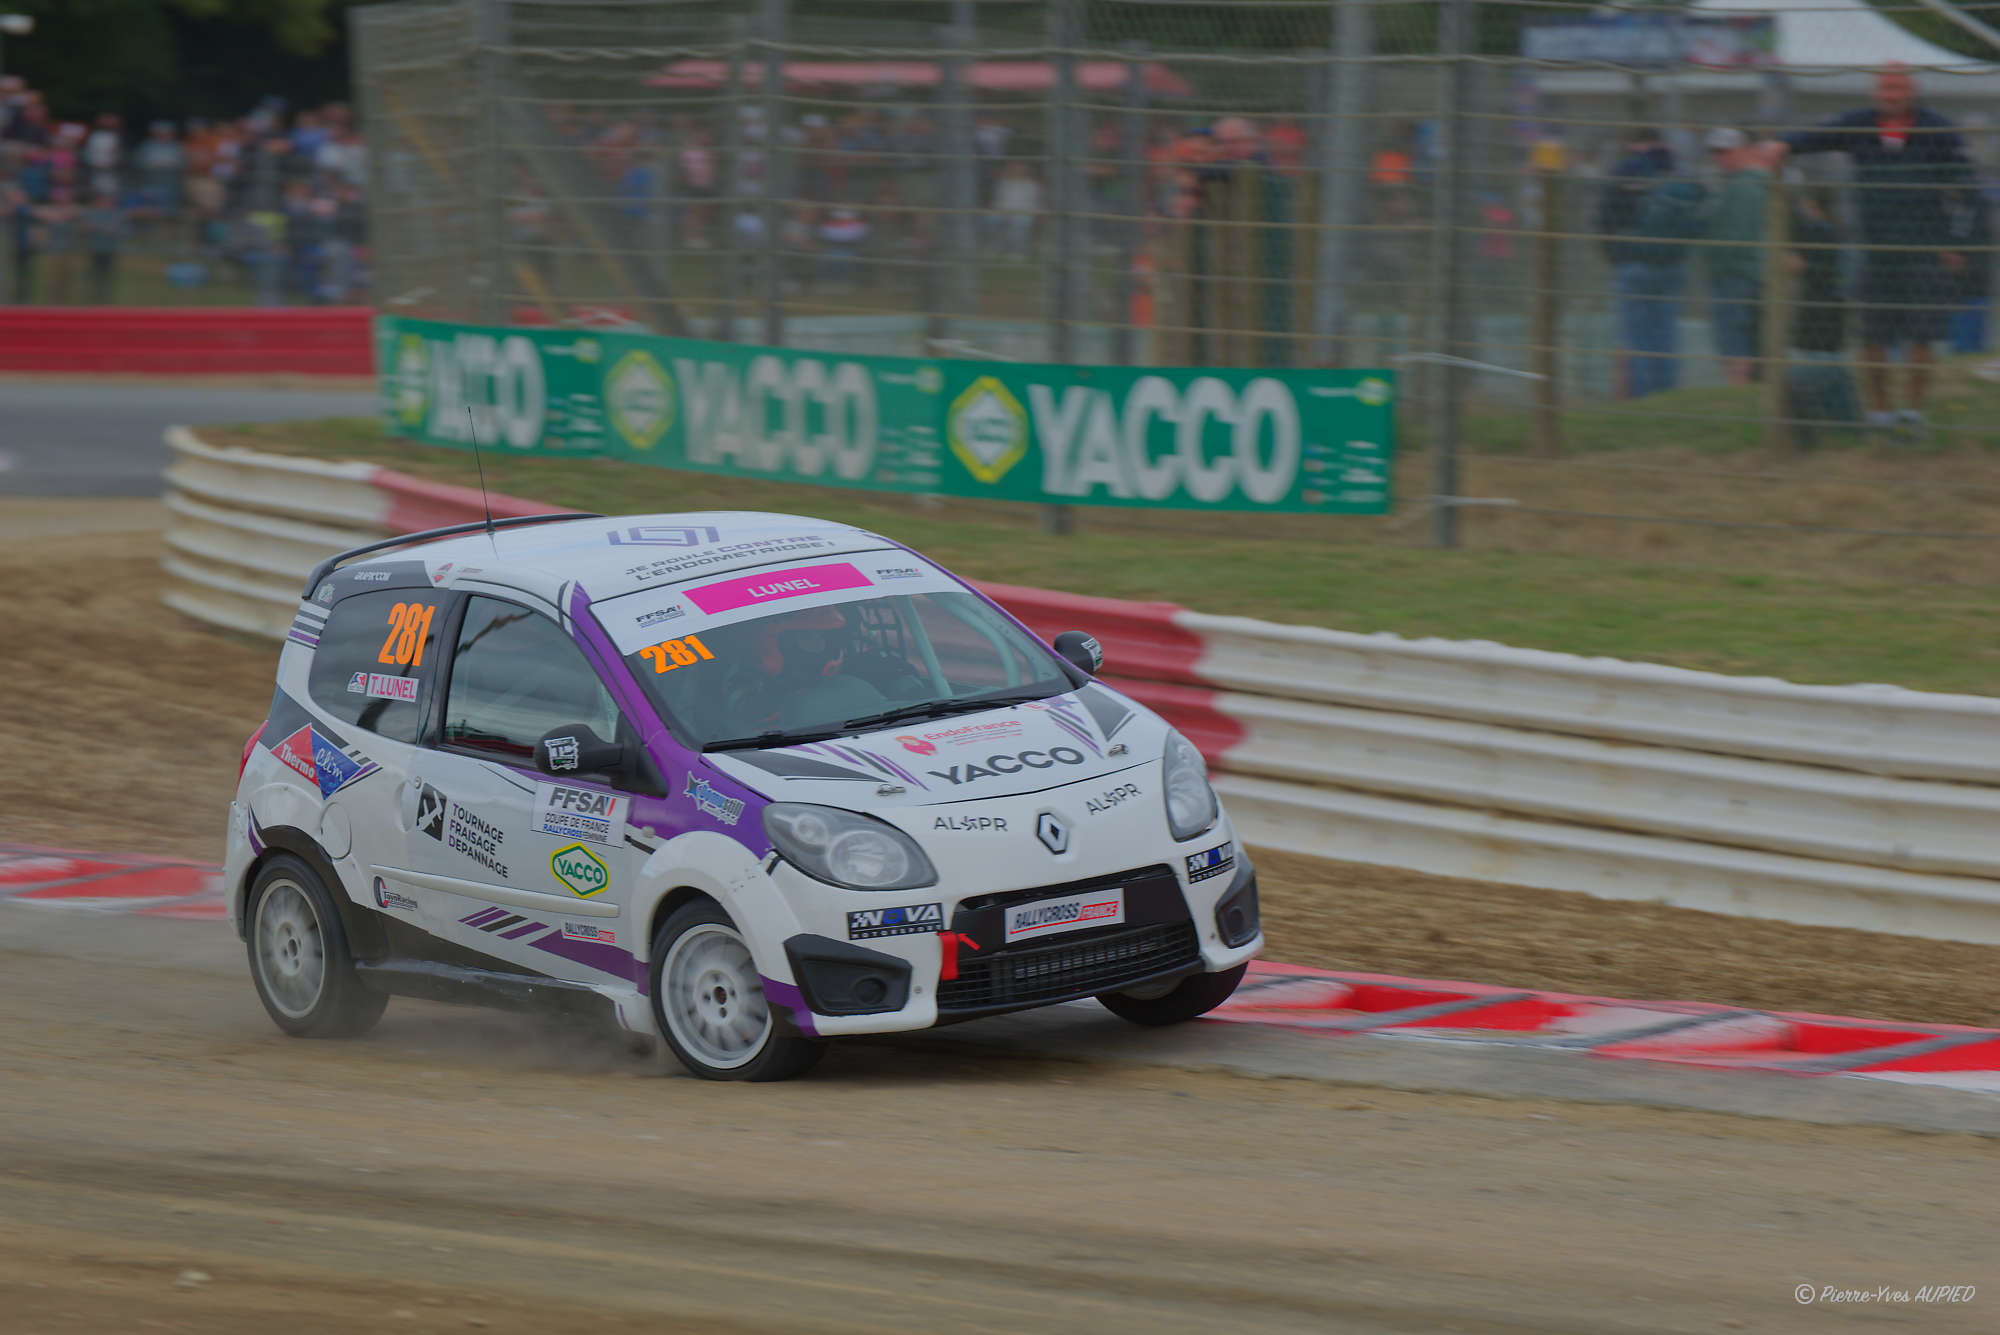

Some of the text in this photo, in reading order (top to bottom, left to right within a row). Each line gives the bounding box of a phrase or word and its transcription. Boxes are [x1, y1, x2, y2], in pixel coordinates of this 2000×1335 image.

[671, 354, 878, 481] YACCO
[1027, 375, 1299, 504] YACCO
[625, 536, 822, 575] JE ROULE CONTRE
[635, 542, 825, 581] L'ENDOMETRIOSE
[747, 578, 821, 598] LUNEL
[636, 606, 677, 622] FFSA
[378, 602, 436, 667] 281
[639, 634, 716, 674] 281
[371, 675, 415, 699] T.LUNEL
[923, 720, 1022, 740] EndoFrance
[280, 743, 316, 778] Thermo
[927, 746, 1085, 785] YACCO
[549, 787, 606, 816] FFSA
[449, 819, 496, 856] FRAISAGE
[453, 803, 504, 844] TOURNAGE
[545, 812, 609, 834] COUPE DE FRANCE
[448, 835, 508, 878] DEPANNAGE
[558, 857, 603, 885] YACCO
[851, 905, 940, 928] NOVA
[1015, 902, 1080, 930] RALLYCROSS
